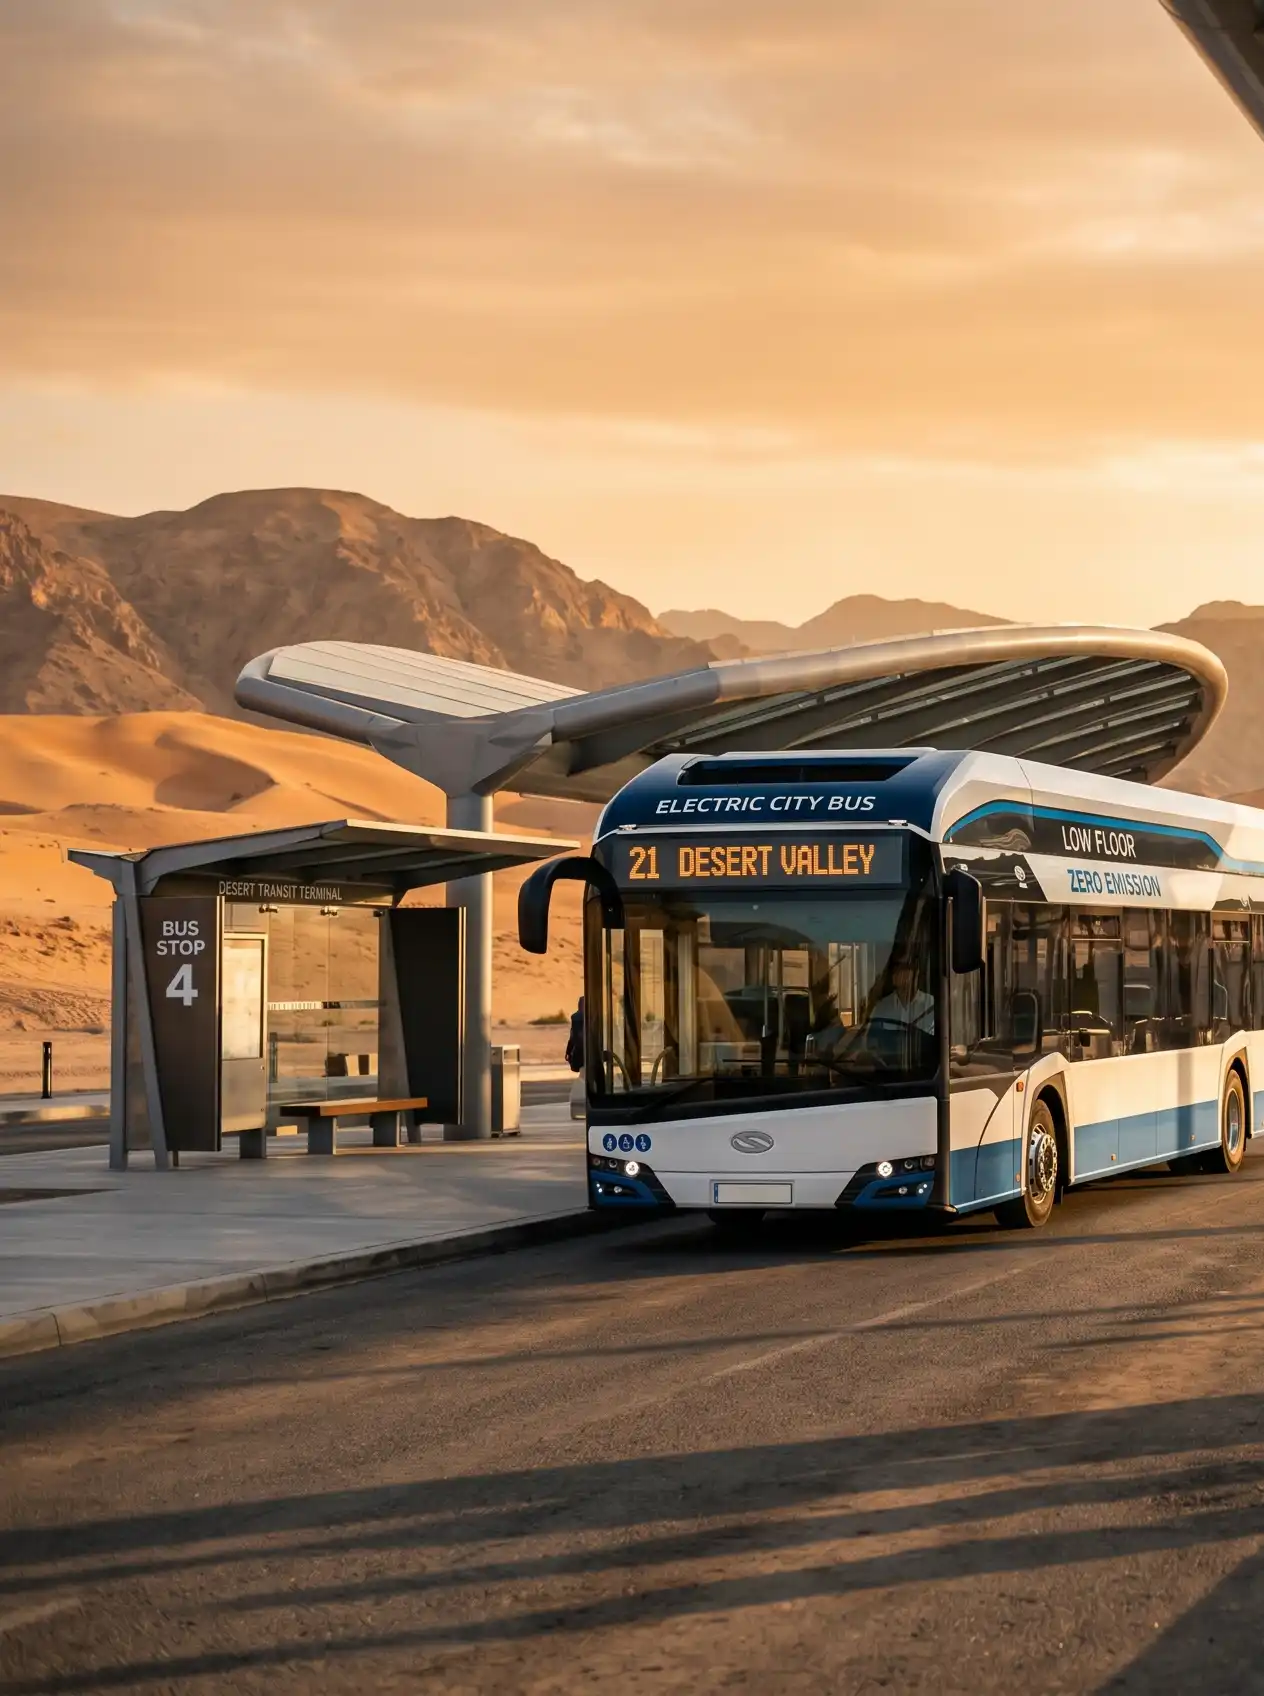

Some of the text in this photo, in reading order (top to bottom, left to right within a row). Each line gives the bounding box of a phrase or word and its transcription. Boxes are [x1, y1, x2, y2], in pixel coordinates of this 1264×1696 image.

[655, 795, 876, 814] ELECTRIC CITY BUS
[1061, 825, 1137, 858] LOW FLOOR
[629, 844, 875, 880] 21 DESERT VALLEY
[218, 880, 343, 901] DESERT TRANSIT TERMINAL
[1066, 868, 1162, 898] ZERO EMISSION
[162, 920, 200, 936] BUS
[156, 939, 206, 956] STOP
[165, 963, 199, 1007] 4
